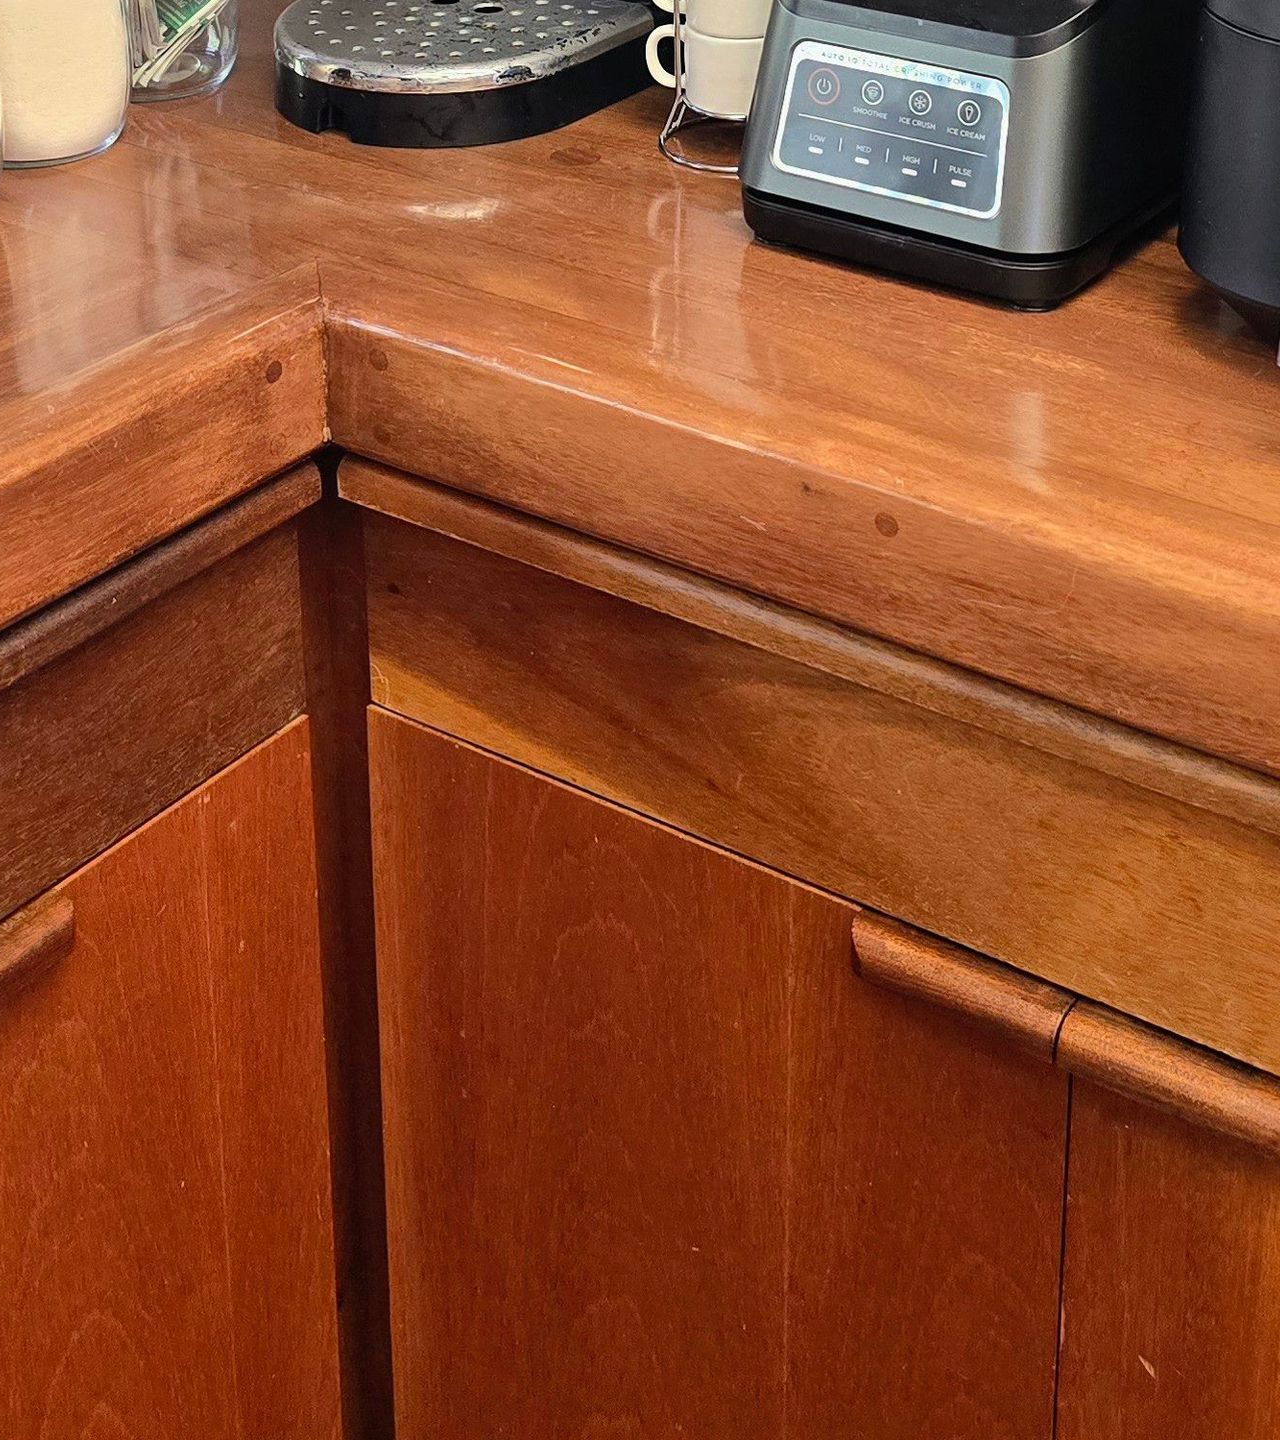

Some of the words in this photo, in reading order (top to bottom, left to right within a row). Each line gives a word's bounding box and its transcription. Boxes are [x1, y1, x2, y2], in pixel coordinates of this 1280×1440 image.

[853, 105, 888, 121] SMOOTHIE
[898, 116, 910, 126] ICE
[911, 118, 937, 131] CRUSH
[809, 133, 827, 143] LOW
[946, 126, 959, 136] ICE
[959, 129, 987, 142] CREAM
[856, 143, 872, 154] MED
[902, 153, 921, 165] HIGH
[948, 164, 973, 177] PULSE
